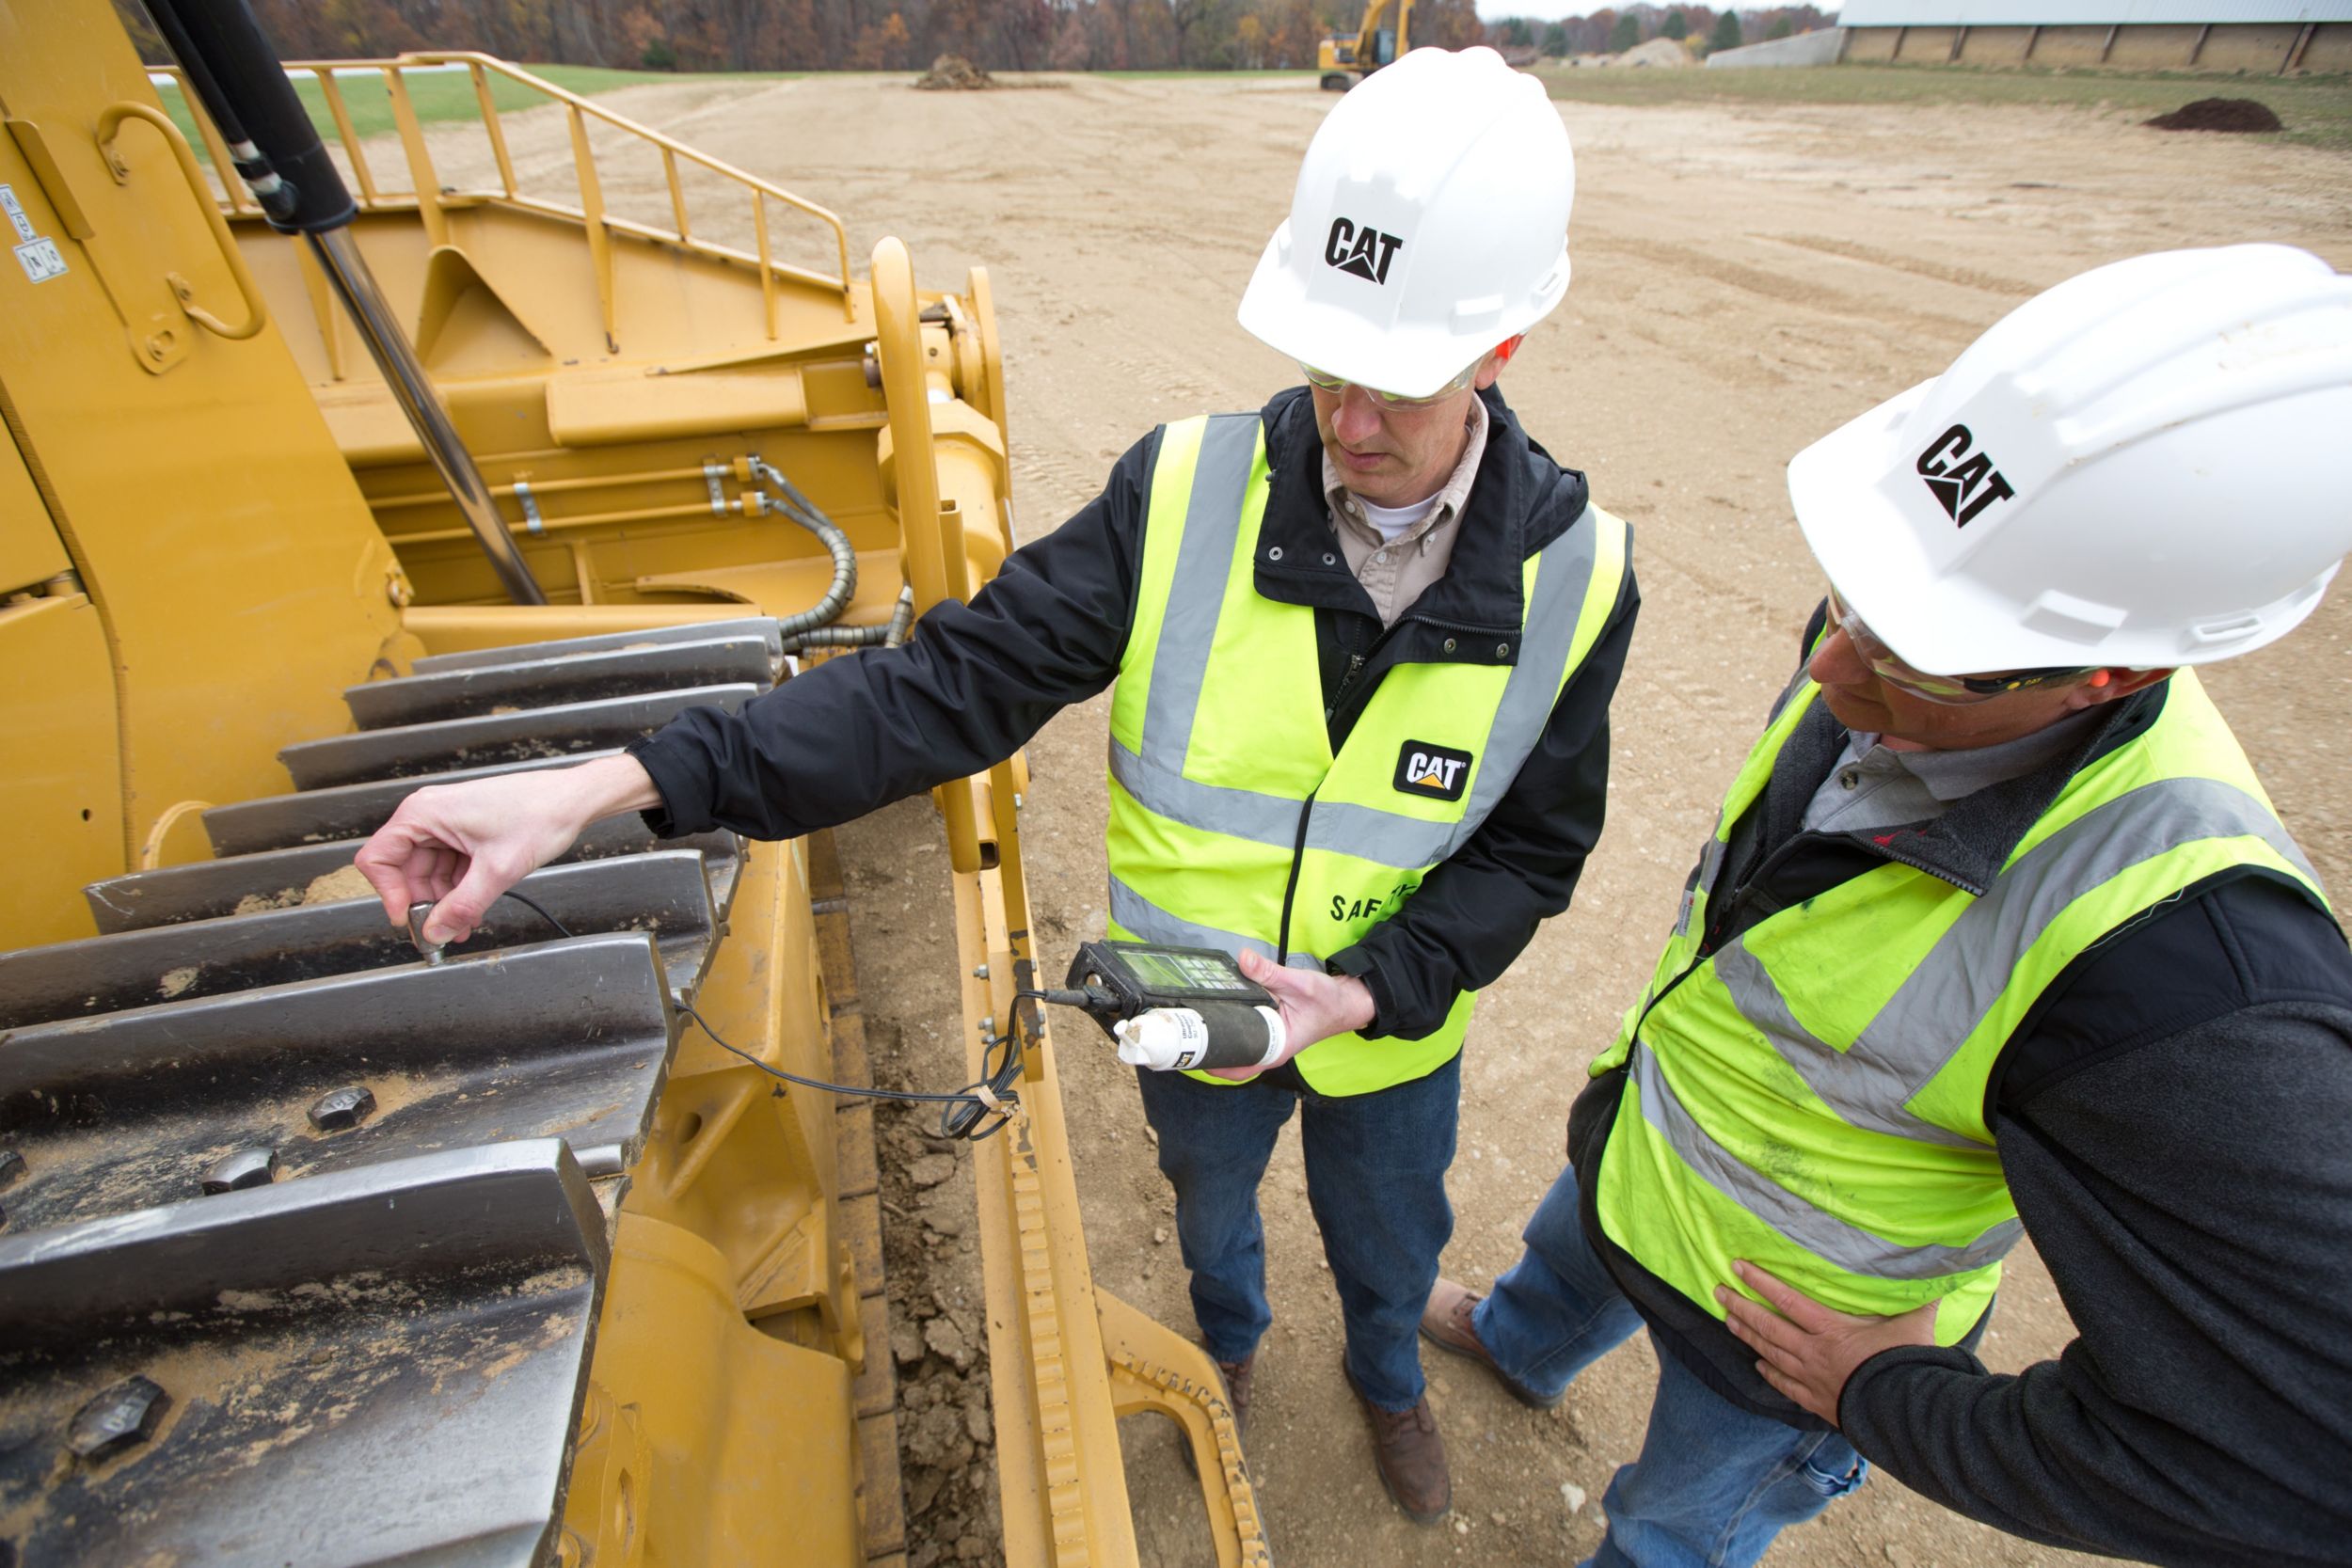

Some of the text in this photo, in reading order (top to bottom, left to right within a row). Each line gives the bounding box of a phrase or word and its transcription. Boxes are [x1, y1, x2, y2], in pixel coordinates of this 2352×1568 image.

[1325, 216, 1404, 286] CAT
[1916, 423, 2015, 529] CAT
[1406, 752, 1462, 790] CAT
